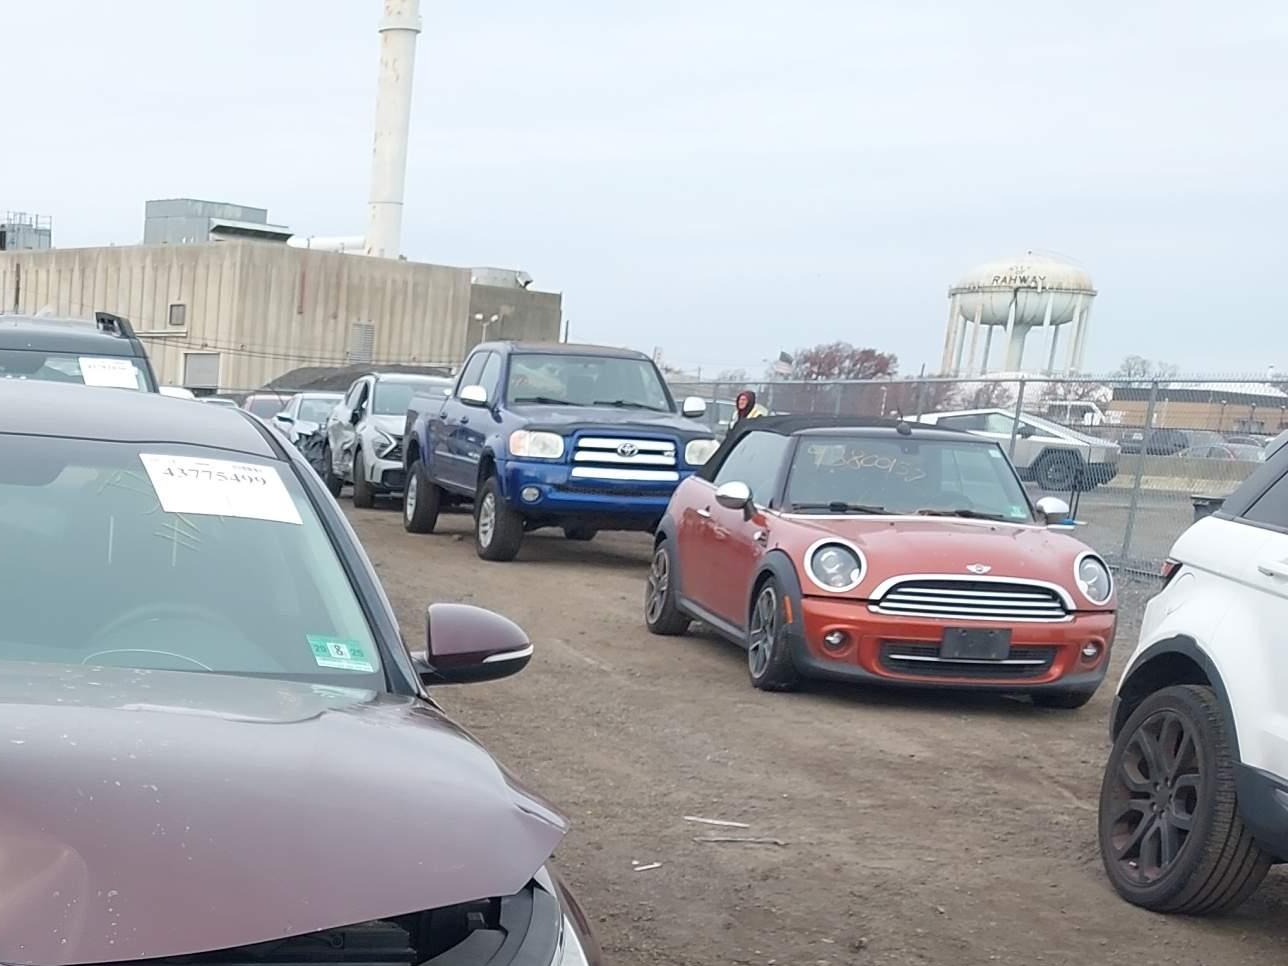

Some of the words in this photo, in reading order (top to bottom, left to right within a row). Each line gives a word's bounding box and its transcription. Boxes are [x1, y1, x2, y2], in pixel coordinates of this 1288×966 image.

[992, 275, 1046, 284] RAHWAY
[162, 467, 267, 486] 43775499
[334, 644, 344, 656] 8
